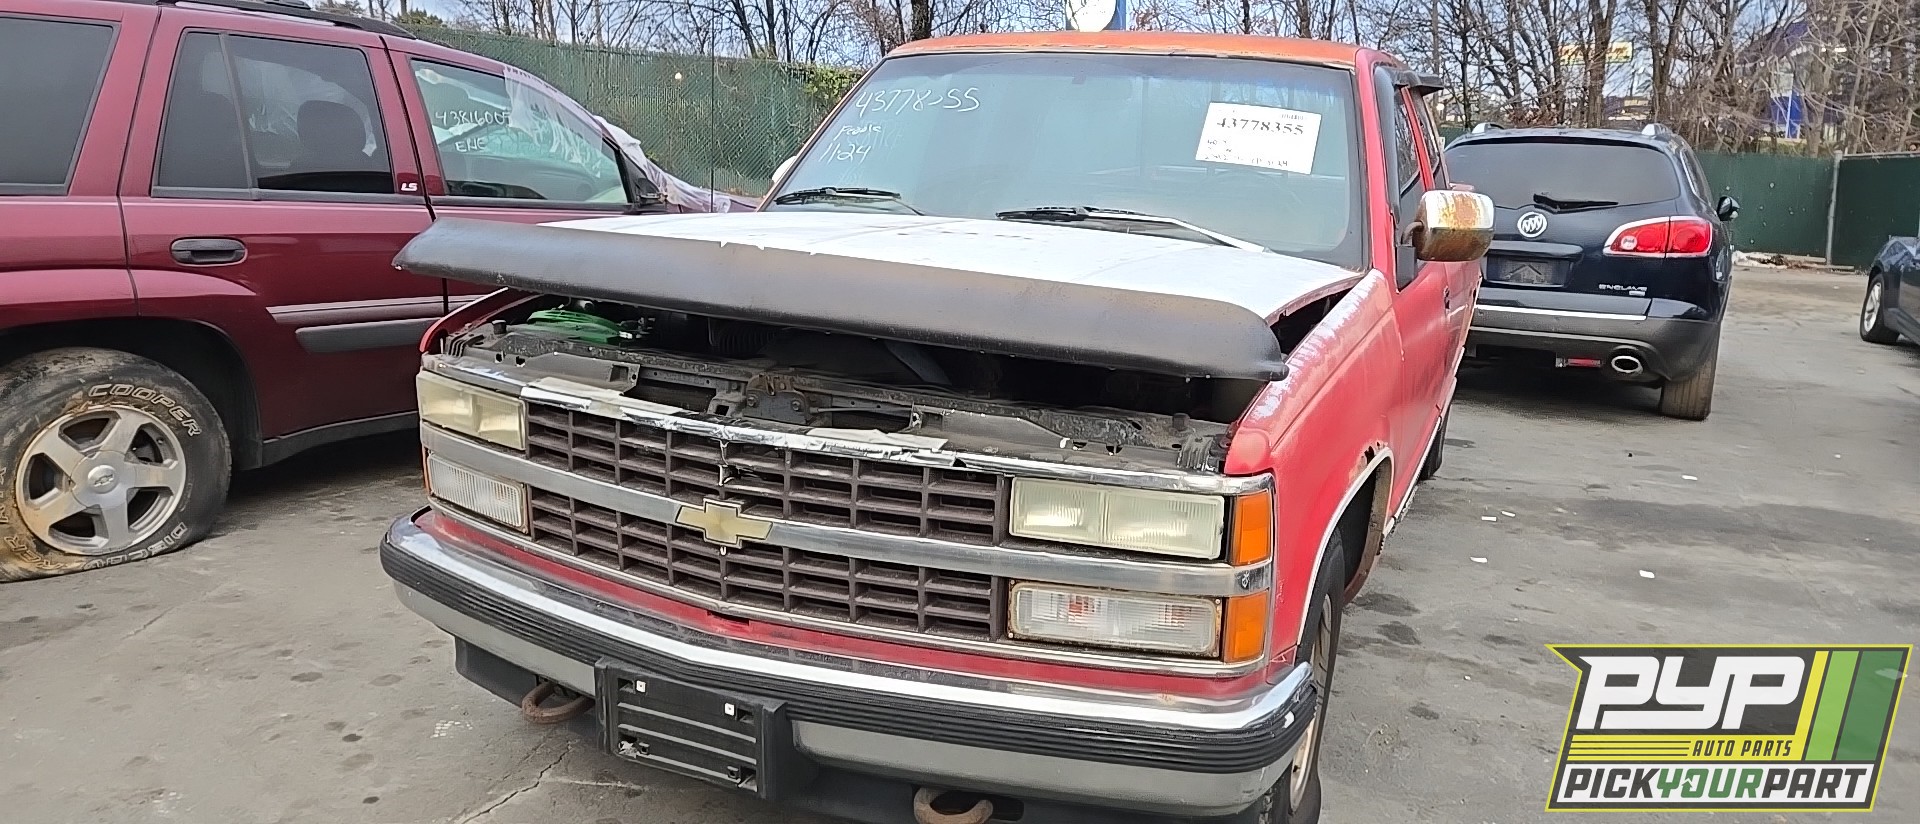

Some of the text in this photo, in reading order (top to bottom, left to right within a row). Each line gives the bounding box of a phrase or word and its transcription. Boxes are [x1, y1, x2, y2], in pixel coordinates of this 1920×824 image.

[1217, 117, 1304, 135] 43778355
[400, 182, 418, 192] LS
[88, 383, 202, 437] COOPER
